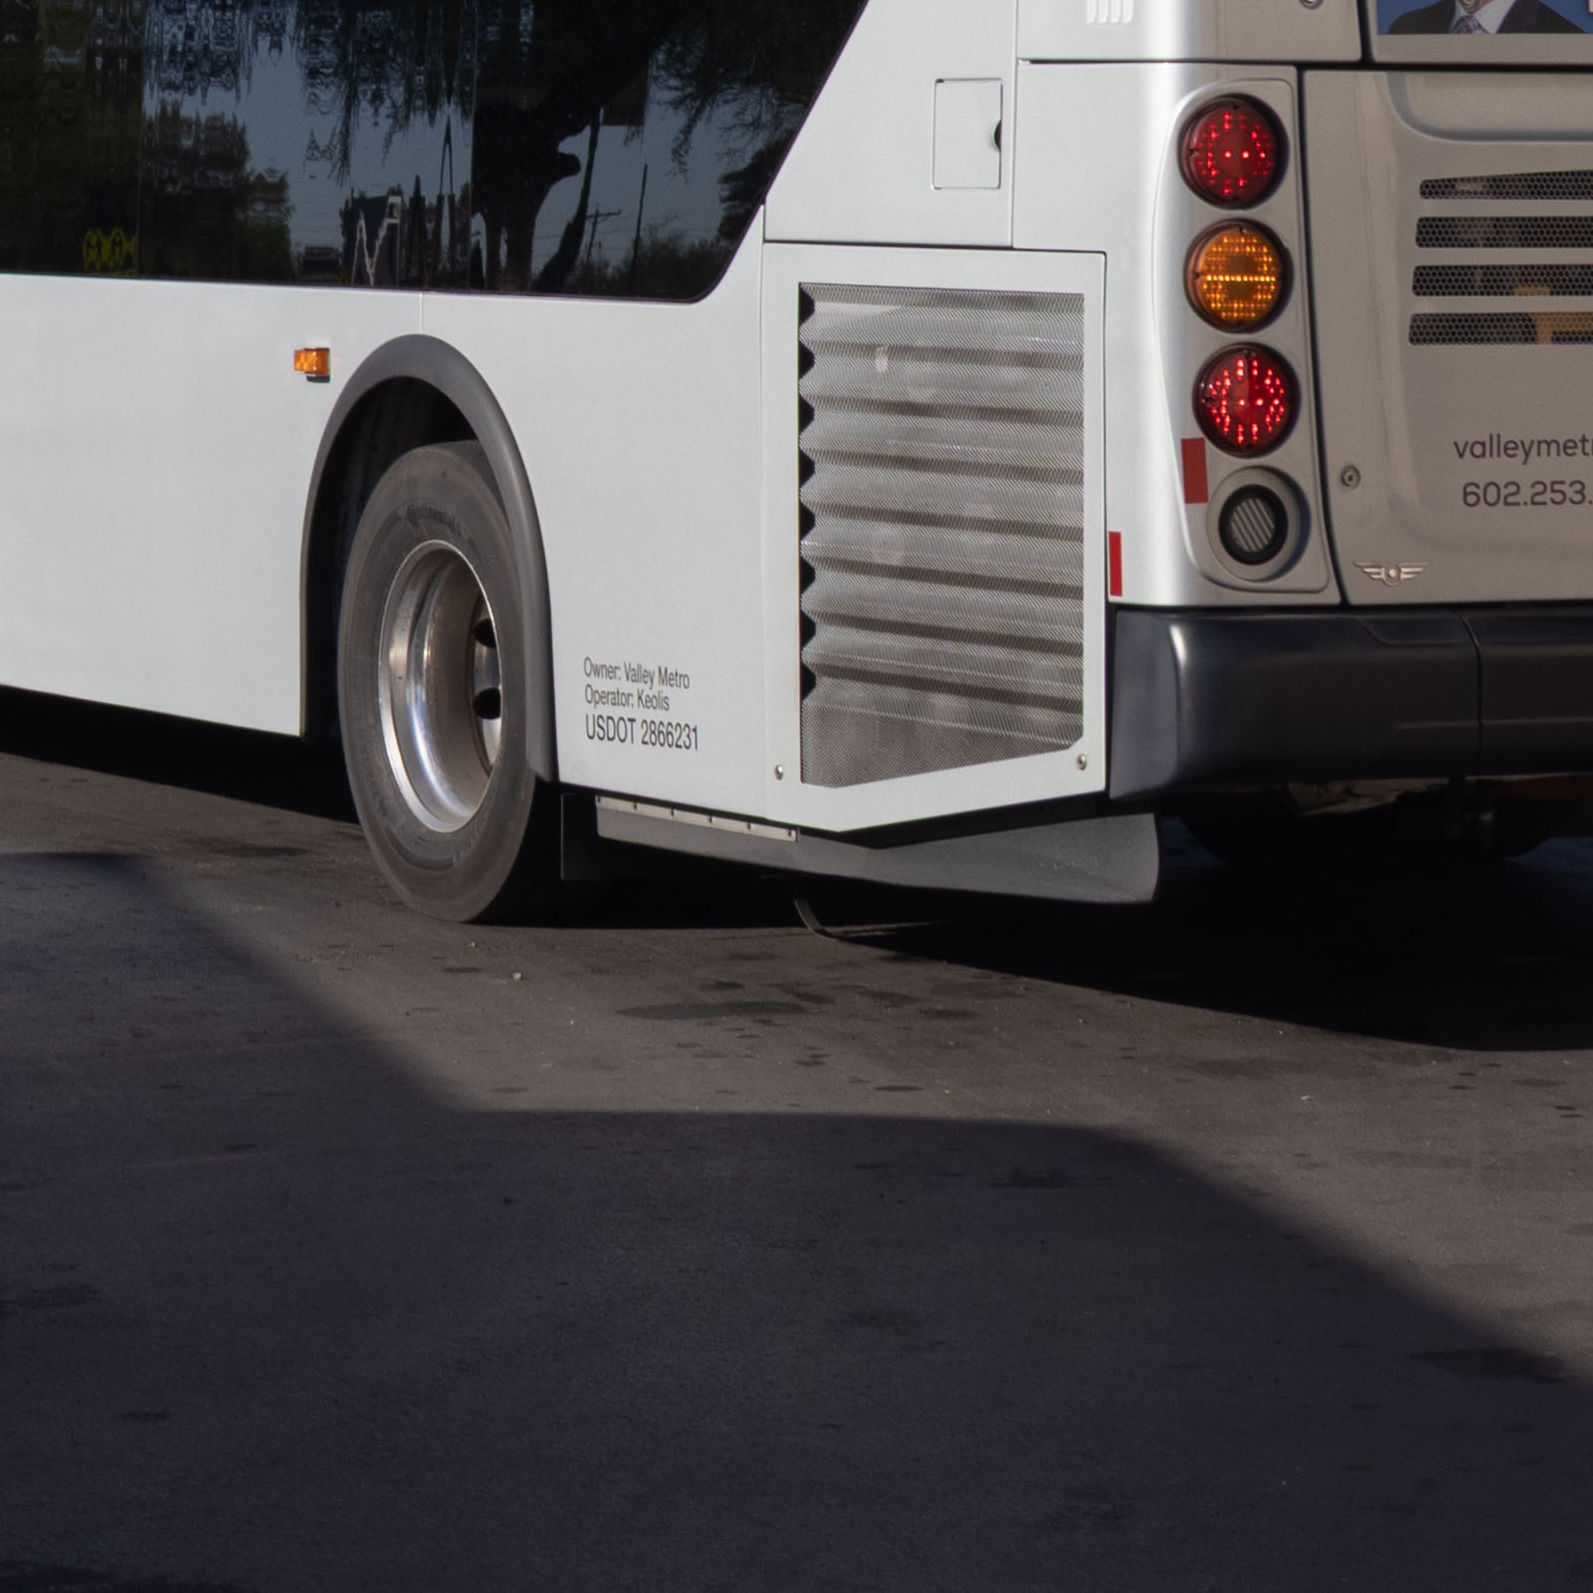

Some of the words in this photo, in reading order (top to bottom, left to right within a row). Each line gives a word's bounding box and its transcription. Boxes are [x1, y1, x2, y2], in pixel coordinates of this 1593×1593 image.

[583, 656, 621, 681] Owner:
[623, 661, 656, 690] Valley
[657, 666, 690, 690] Metro
[585, 684, 635, 709] Operator:
[637, 688, 670, 712] Keolis
[585, 713, 637, 745] USDOT
[640, 719, 699, 751] 2866231
